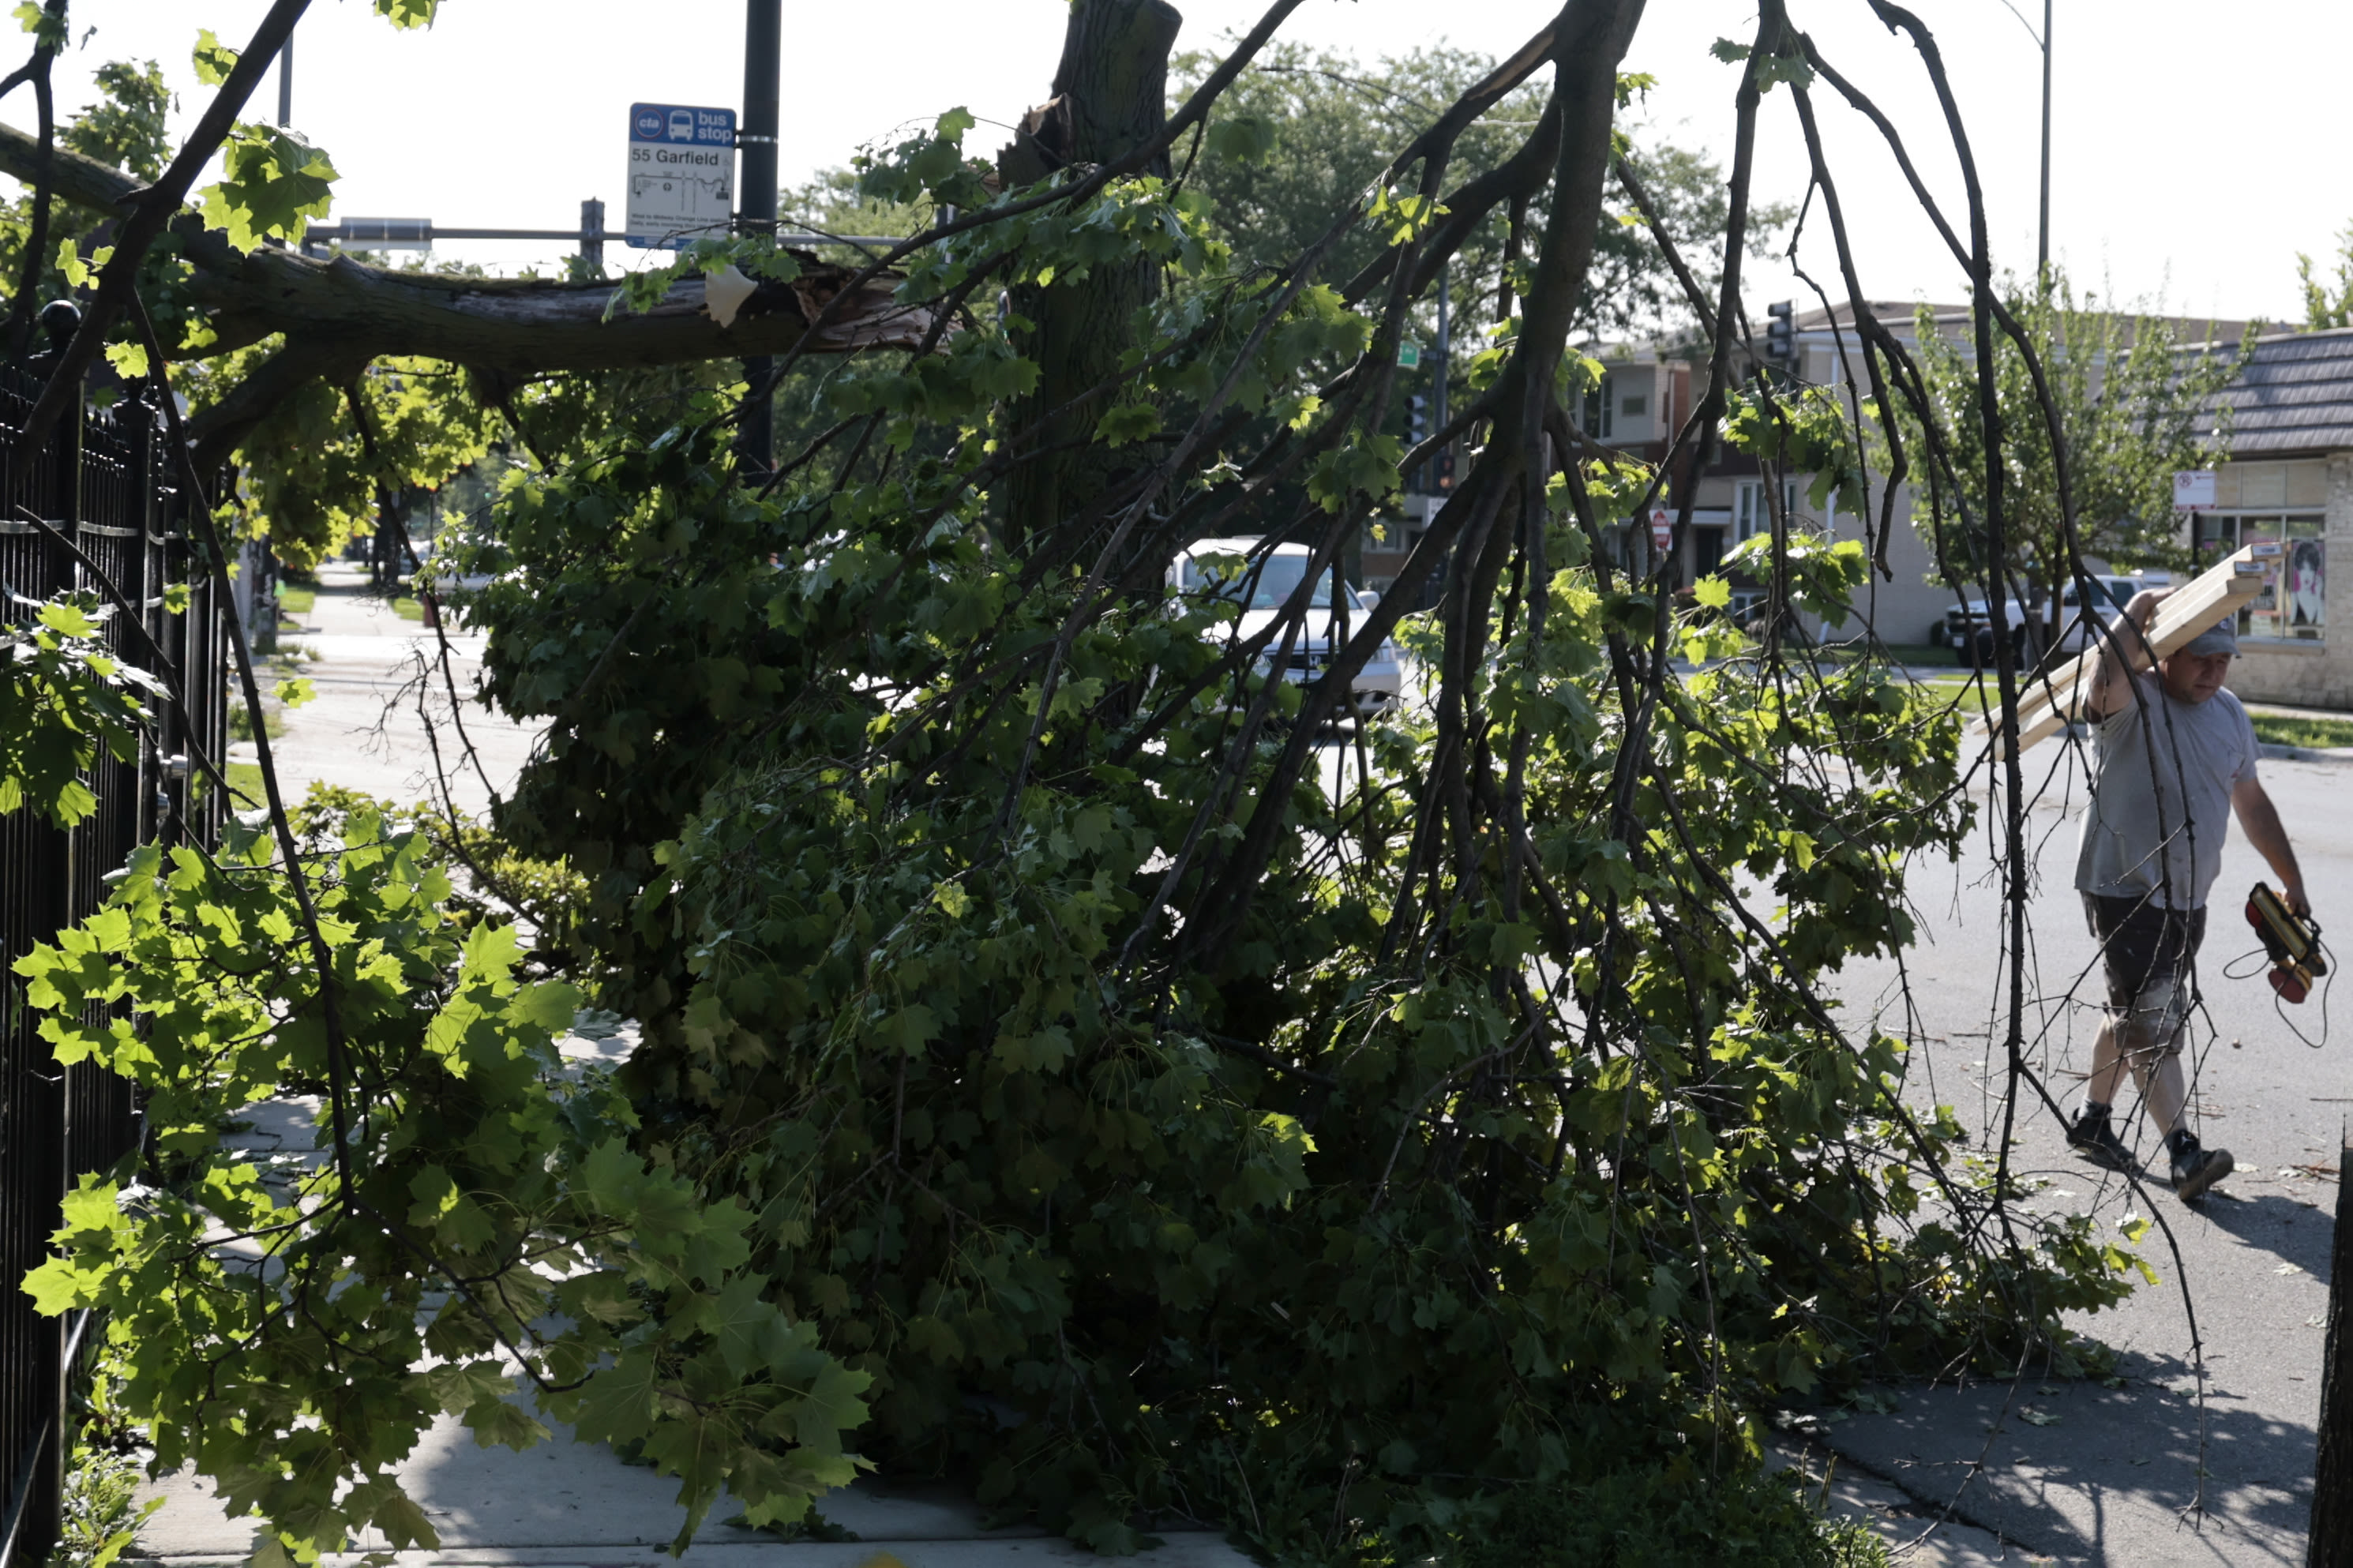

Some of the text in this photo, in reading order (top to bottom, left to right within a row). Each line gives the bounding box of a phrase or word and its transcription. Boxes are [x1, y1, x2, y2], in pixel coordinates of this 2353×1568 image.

[639, 118, 660, 129] cta
[699, 111, 726, 126] bus
[698, 127, 732, 143] stop
[632, 148, 719, 165] 55 Garfield
